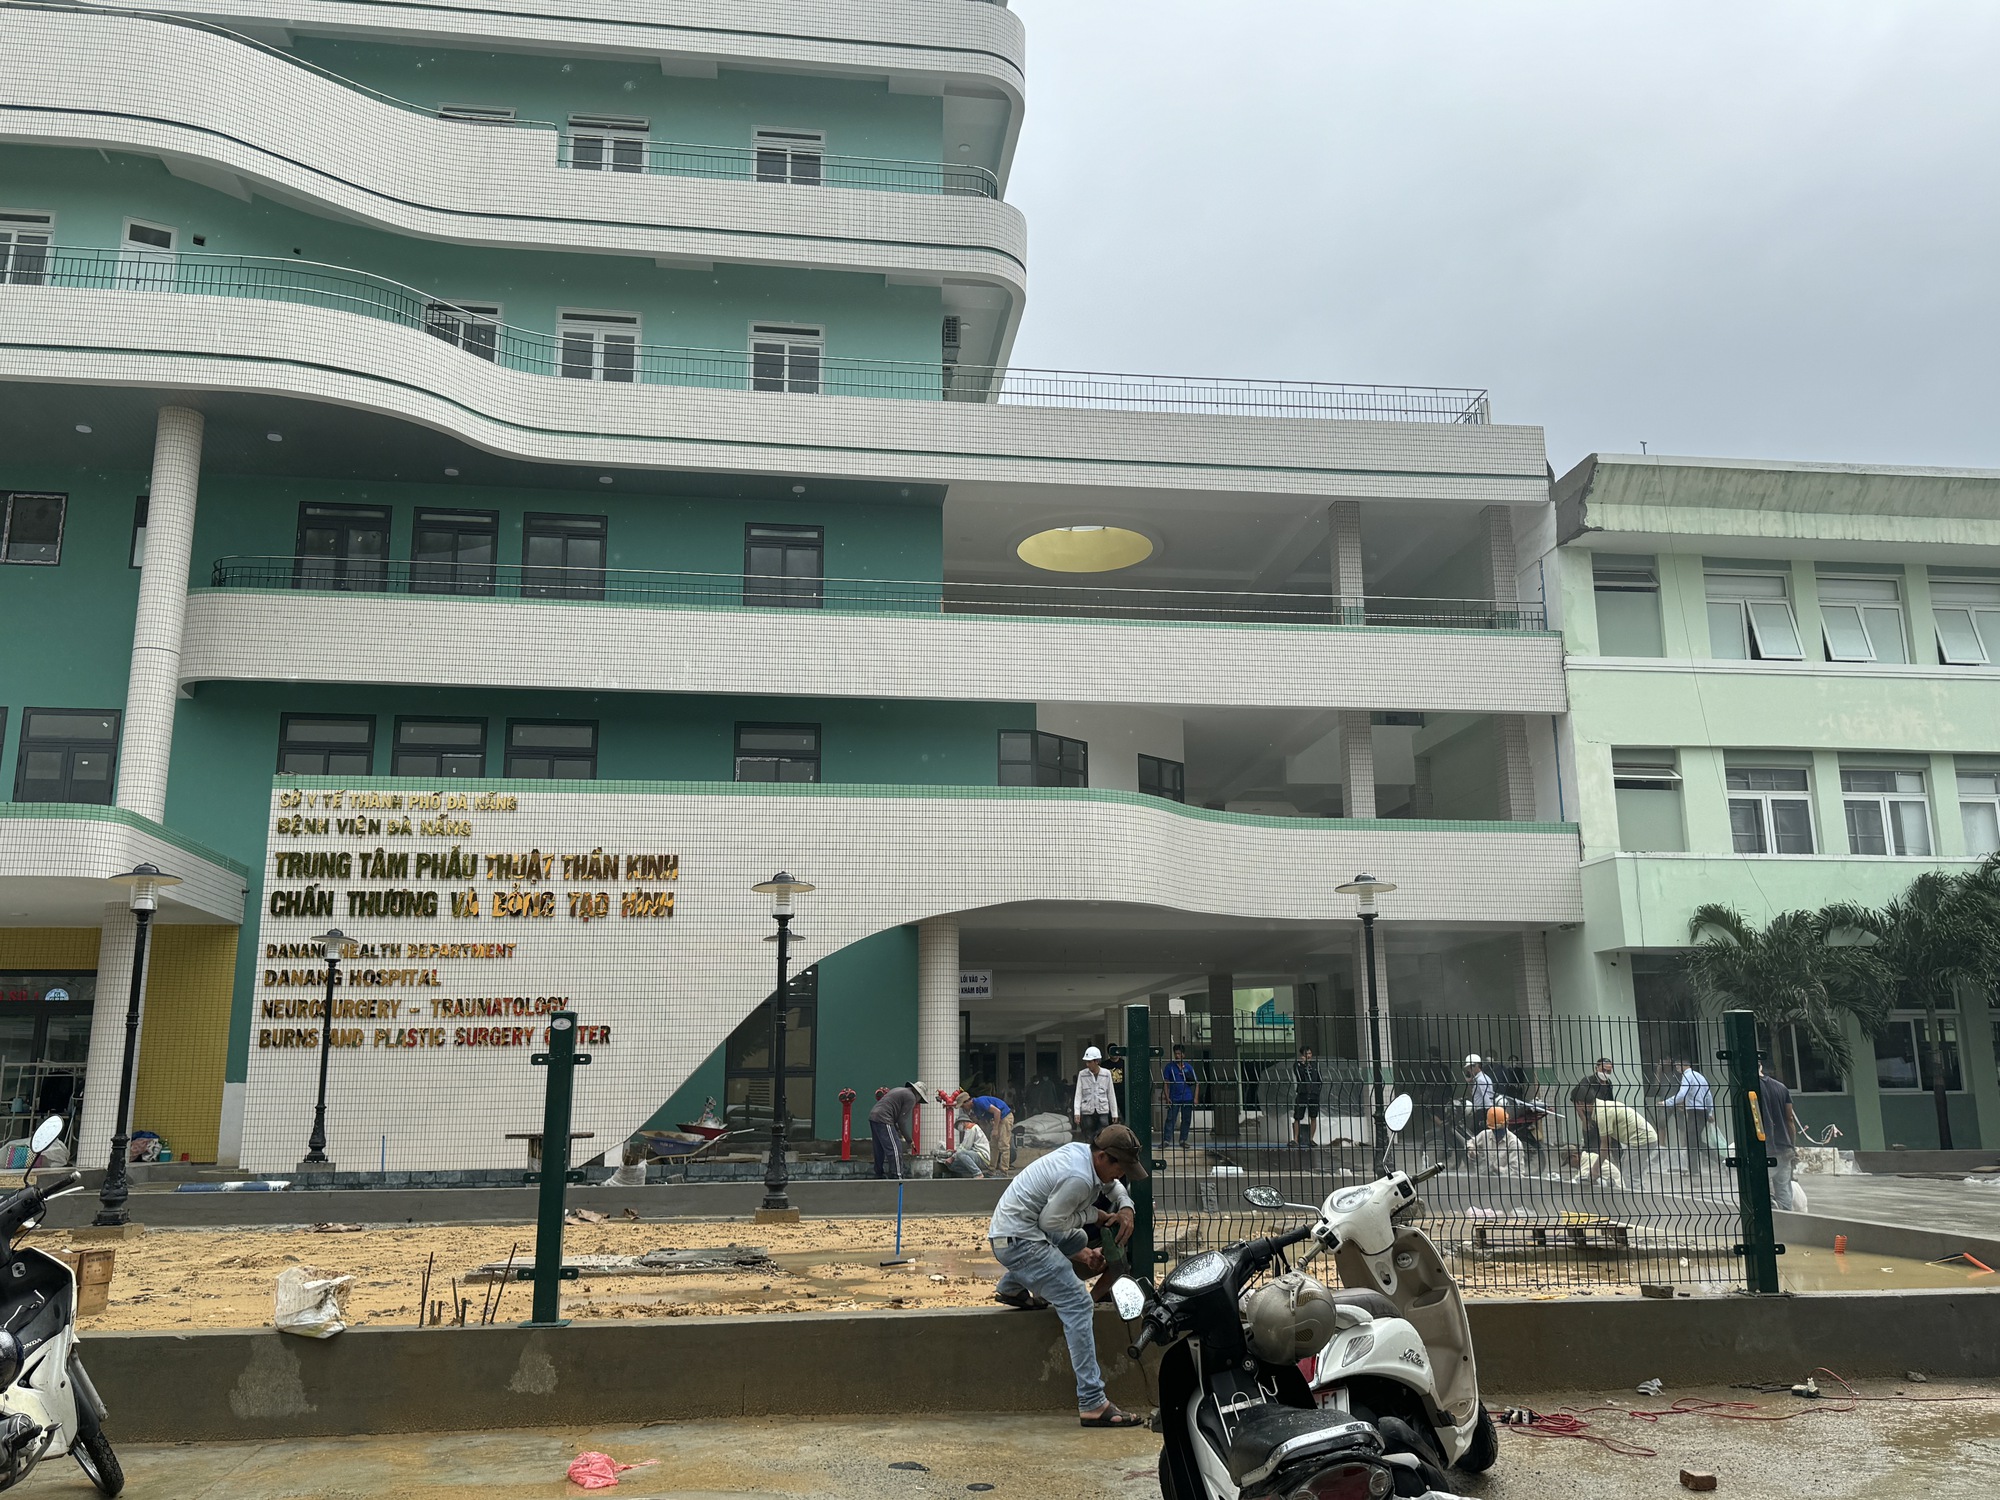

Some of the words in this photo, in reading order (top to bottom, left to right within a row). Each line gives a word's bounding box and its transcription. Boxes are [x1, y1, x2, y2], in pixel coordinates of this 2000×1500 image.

[280, 788, 303, 809] SỞ
[307, 793, 319, 809] Y
[323, 789, 346, 809] TẾ
[349, 791, 403, 810] THÀNH
[408, 791, 444, 810] PHỐ
[447, 792, 468, 811] ĐÀ
[277, 814, 330, 838] BỆNH
[337, 815, 381, 838] VIỆN
[387, 815, 413, 837] ĐÀ
[275, 852, 352, 879] TRUNG
[359, 847, 409, 879] TÂM
[485, 848, 555, 884] THUẬT
[626, 854, 679, 880] KINH
[270, 883, 335, 917] CHẤN
[346, 889, 438, 917] THƯƠNG
[450, 887, 479, 918] VÀ
[491, 882, 556, 918] BỎNG
[567, 891, 609, 923] TẠO
[621, 887, 675, 918] HÌNH
[407, 943, 517, 959] DEPARTMENT
[349, 969, 442, 987] HOSPITAL
[259, 1027, 320, 1048] BURNS
[329, 1027, 365, 1048] AND
[373, 1027, 446, 1048] PLASTIC
[454, 1026, 536, 1047] SURGERY
